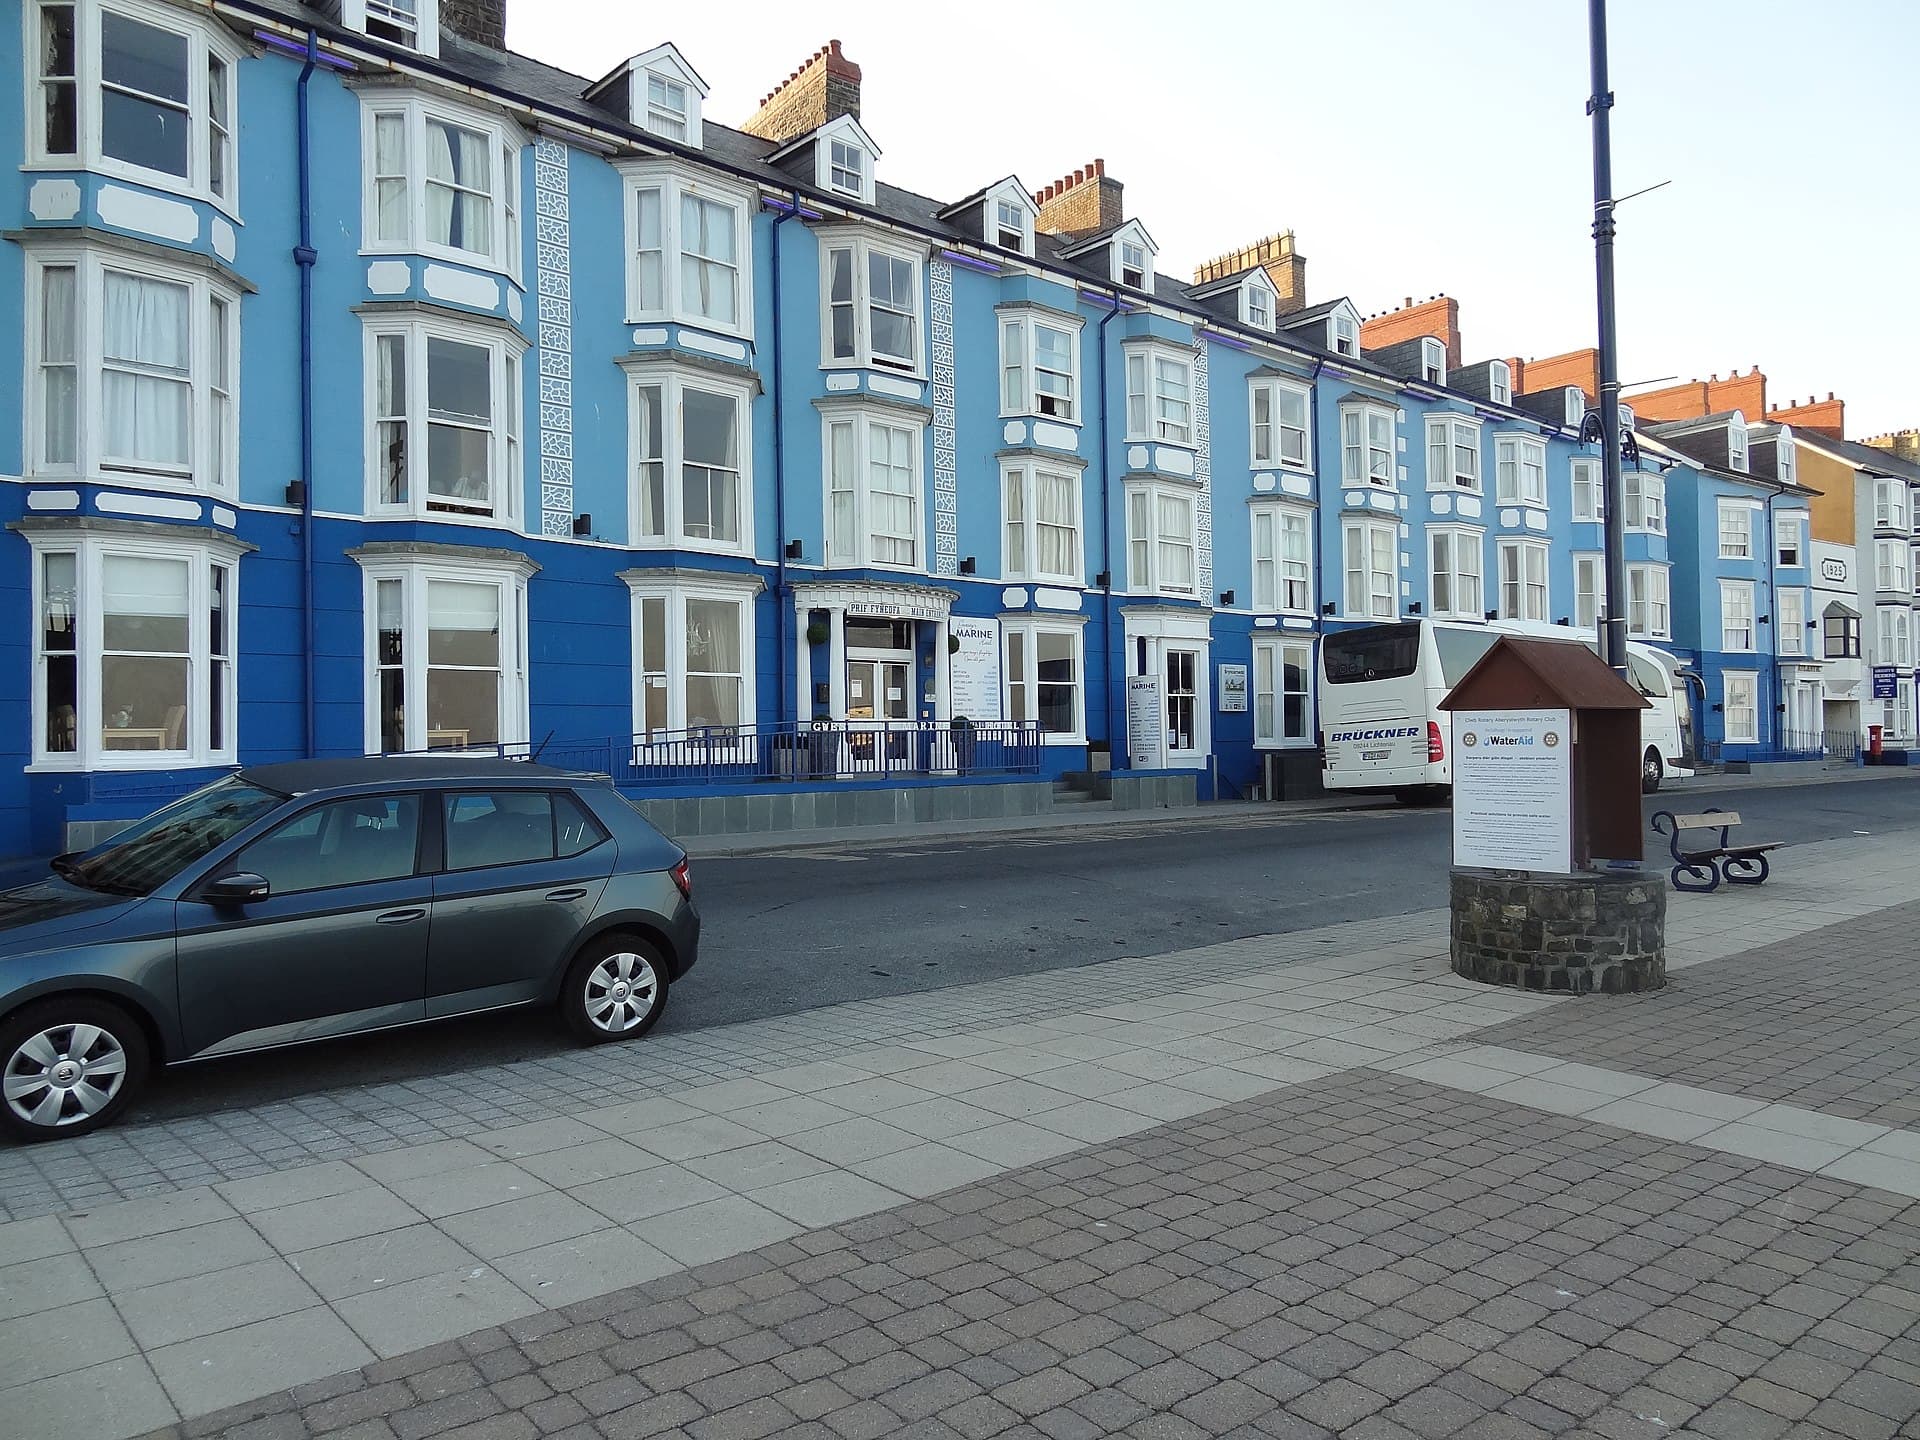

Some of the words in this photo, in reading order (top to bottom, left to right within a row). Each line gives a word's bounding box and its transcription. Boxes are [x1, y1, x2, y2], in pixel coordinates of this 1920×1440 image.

[1826, 565, 1843, 577] 1925
[850, 603, 868, 613] PRIF
[956, 629, 993, 639] MARINE
[1331, 727, 1419, 742] BRÜCKNER
[1490, 735, 1534, 746] WaterAid
